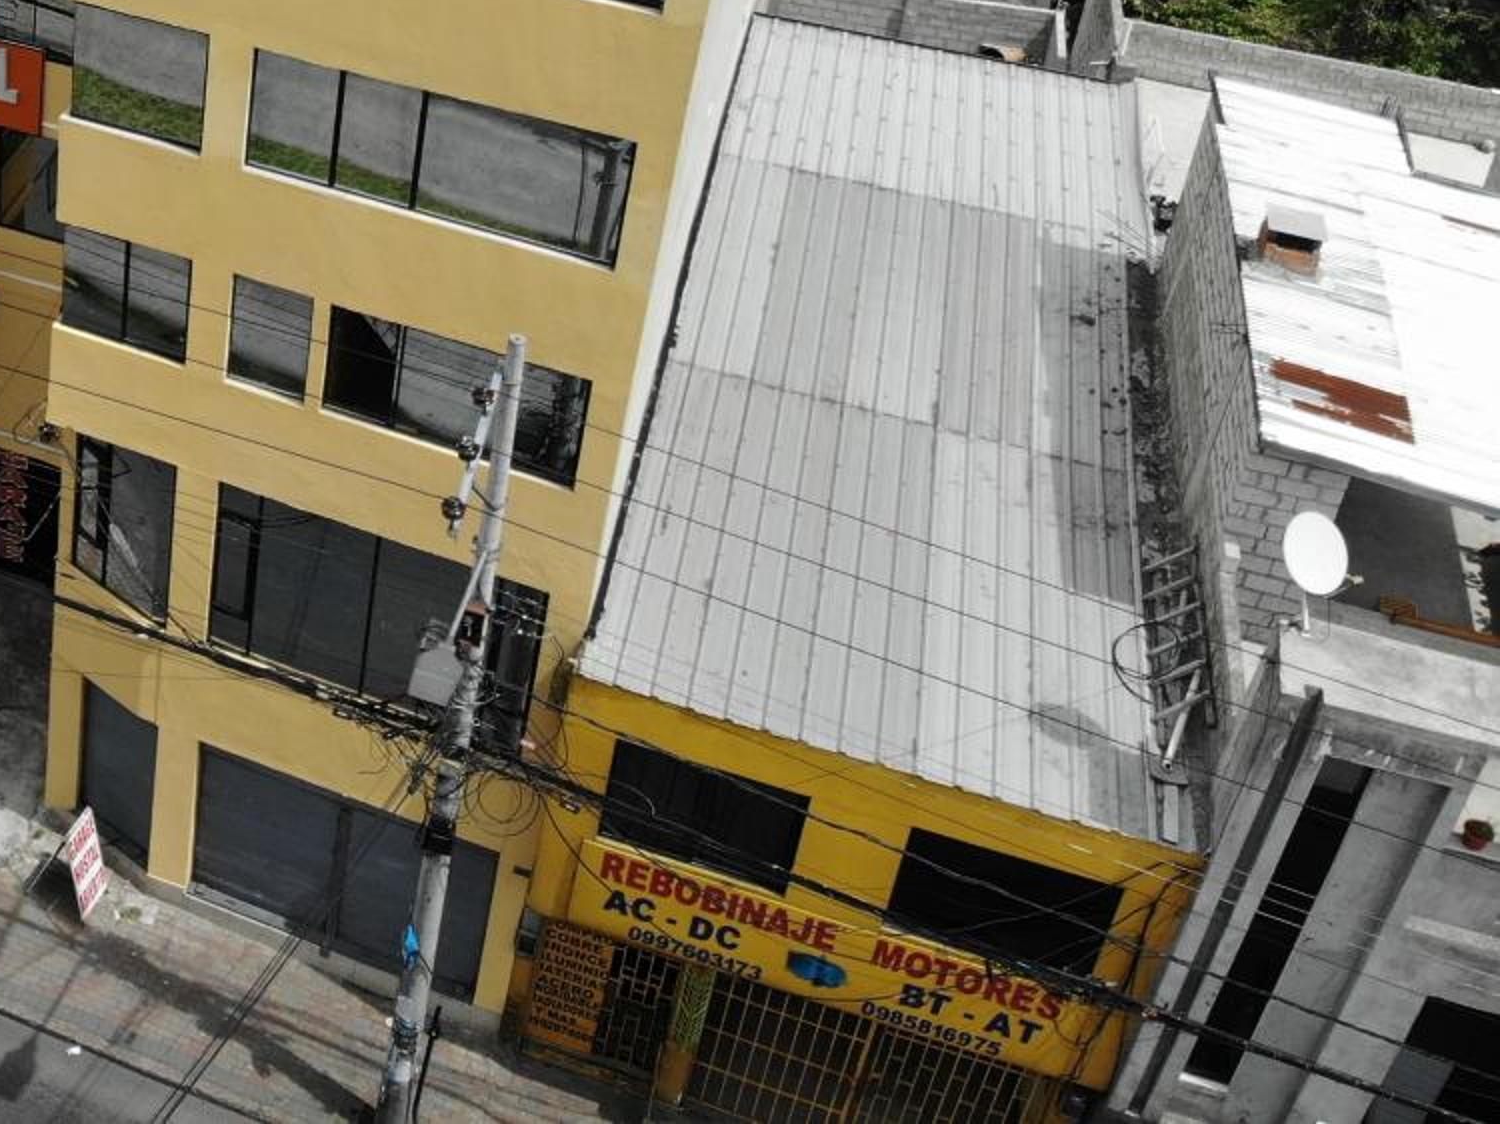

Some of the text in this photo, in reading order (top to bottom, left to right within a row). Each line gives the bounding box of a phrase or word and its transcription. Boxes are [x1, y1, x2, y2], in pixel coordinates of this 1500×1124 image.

[600, 850, 1062, 1019] REBOBINAJE MOTORES
[603, 889, 656, 923] AC
[688, 915, 741, 950] DC
[899, 983, 952, 1016] BT
[982, 1011, 1043, 1044] AT
